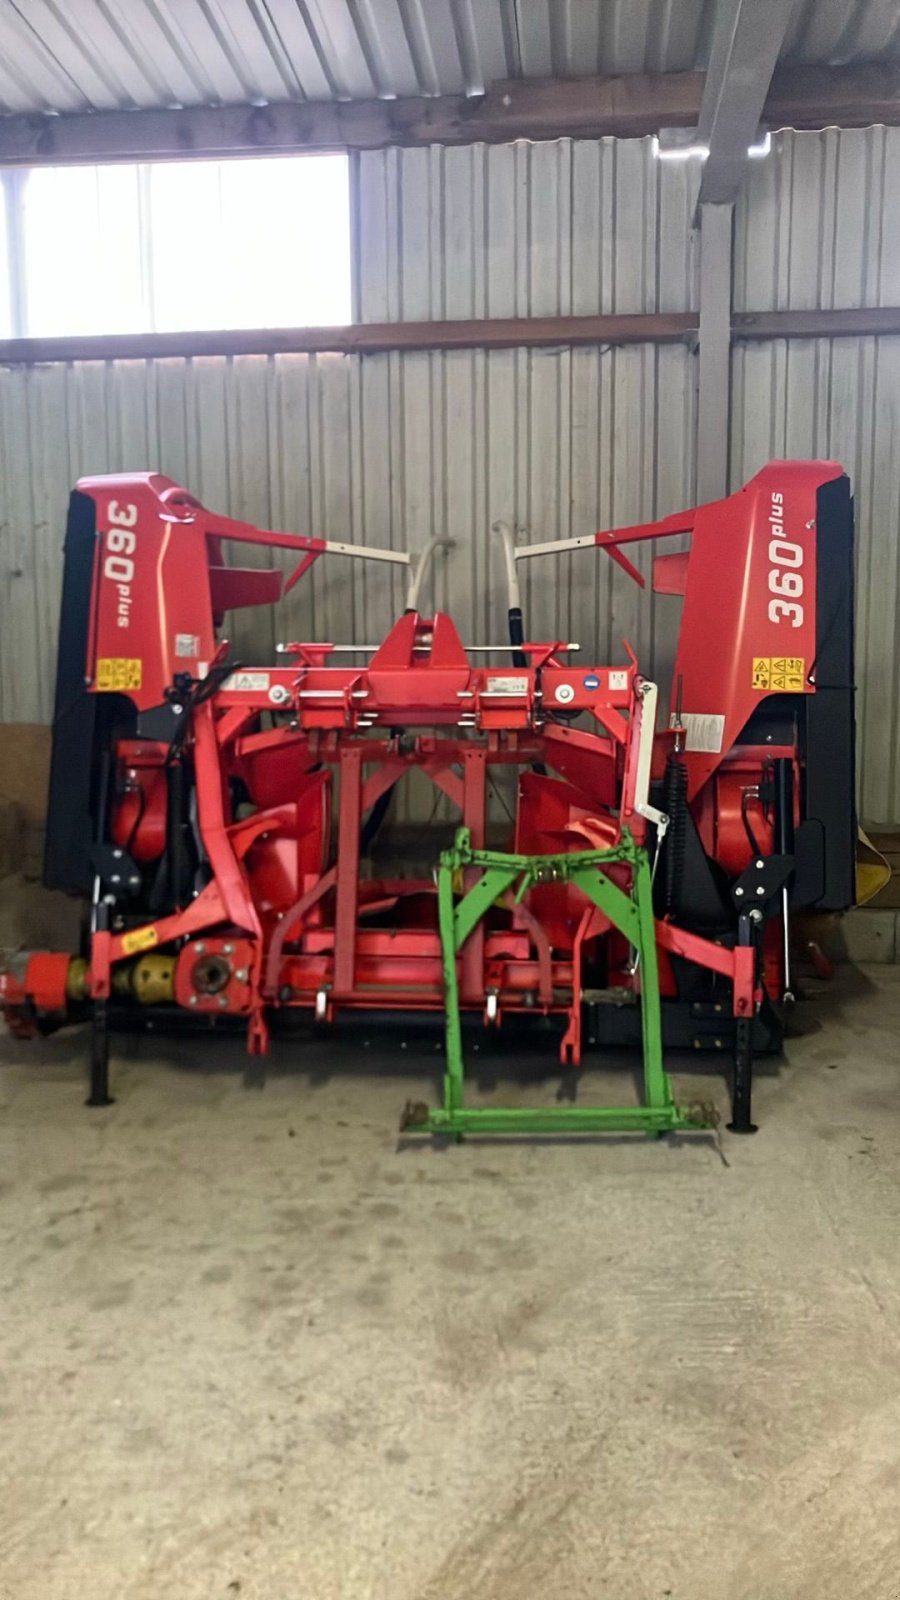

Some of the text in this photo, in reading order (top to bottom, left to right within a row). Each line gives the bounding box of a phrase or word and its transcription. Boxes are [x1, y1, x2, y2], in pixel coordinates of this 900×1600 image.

[104, 500, 138, 583] 360
[768, 492, 804, 628] 360 plus
